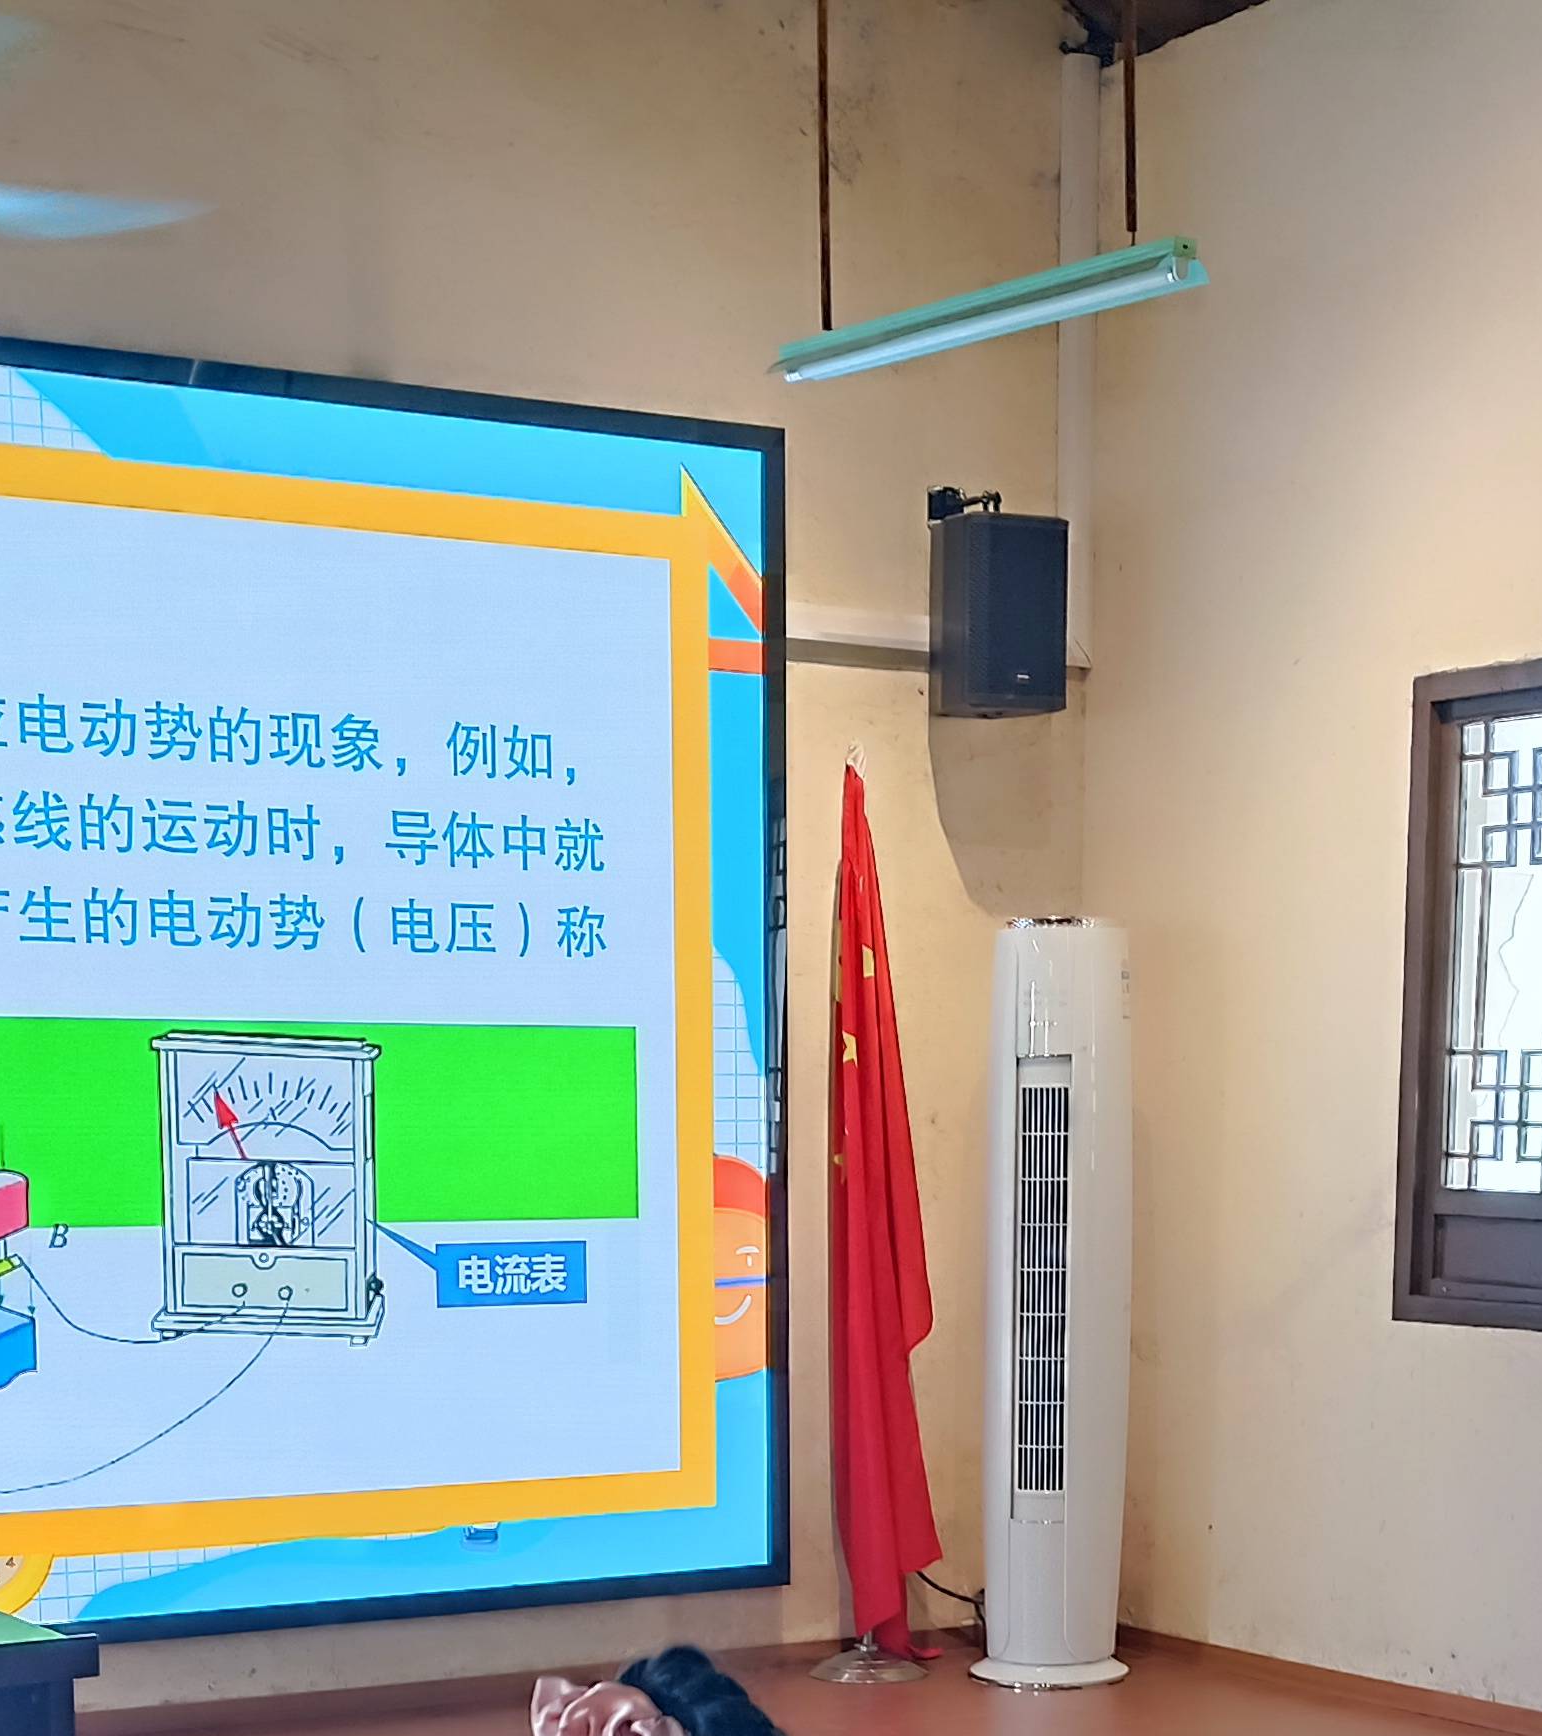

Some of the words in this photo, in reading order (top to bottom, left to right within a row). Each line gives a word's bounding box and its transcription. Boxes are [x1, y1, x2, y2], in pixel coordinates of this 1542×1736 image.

[48, 1223, 69, 1249] B
[458, 1253, 567, 1295] 电流表
